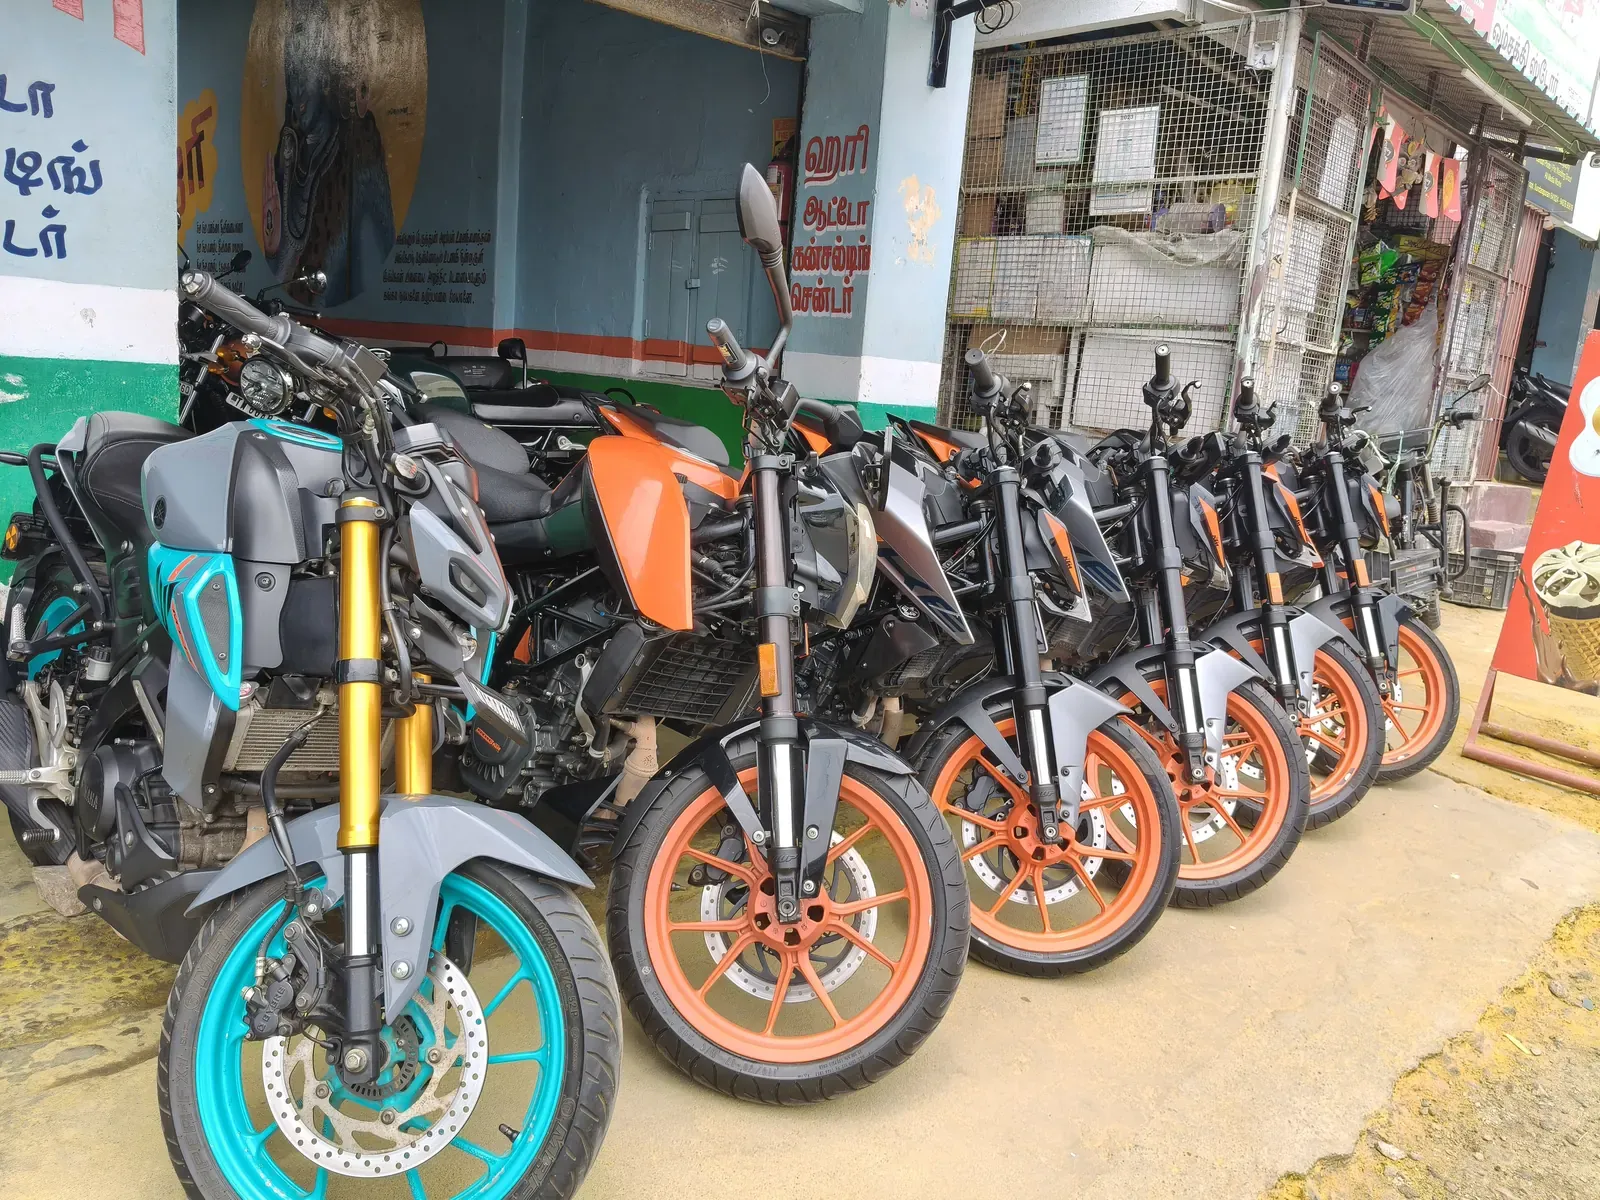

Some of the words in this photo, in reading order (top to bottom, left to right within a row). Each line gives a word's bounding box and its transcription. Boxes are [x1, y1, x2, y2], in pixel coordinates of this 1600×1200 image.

[804, 124, 870, 186] ஹரி
[803, 195, 870, 233] ஆட்டோ
[790, 277, 854, 315] சென்டர்
